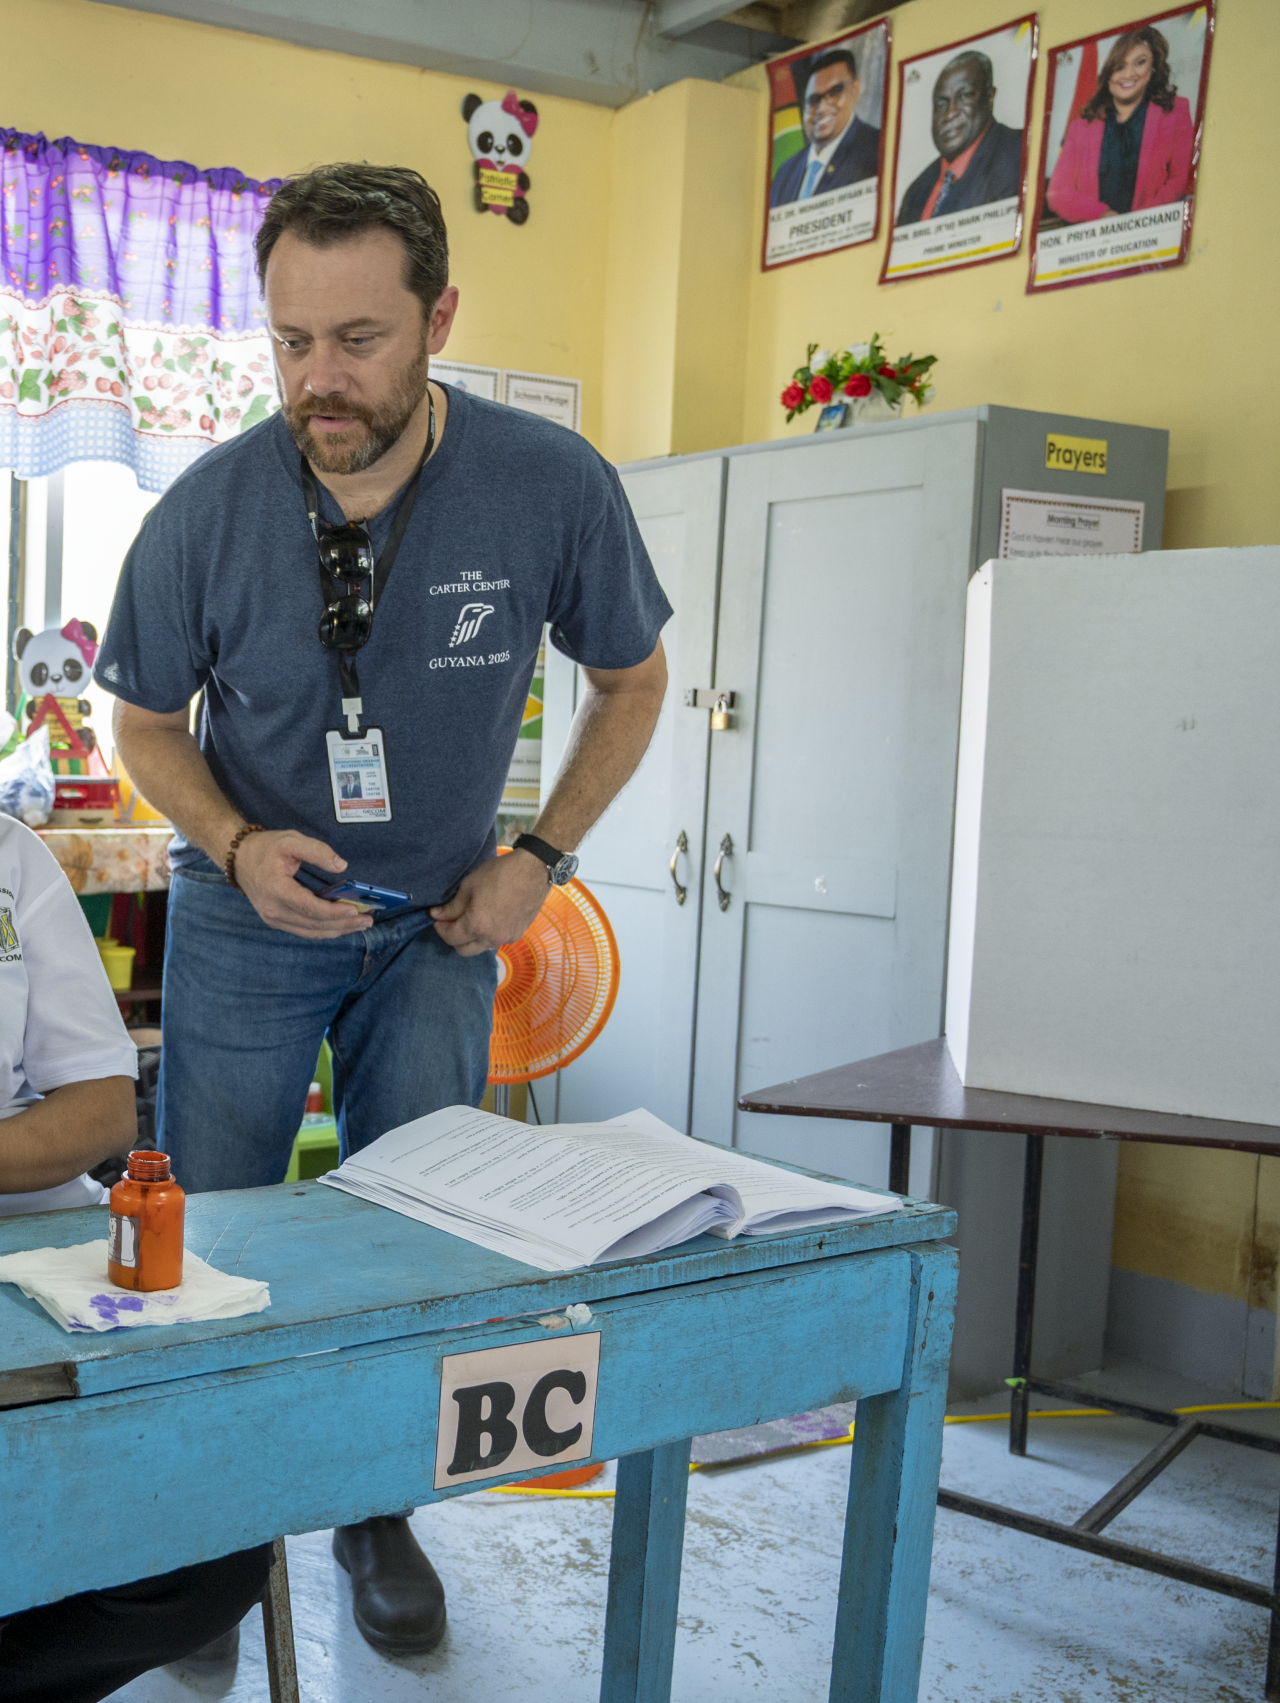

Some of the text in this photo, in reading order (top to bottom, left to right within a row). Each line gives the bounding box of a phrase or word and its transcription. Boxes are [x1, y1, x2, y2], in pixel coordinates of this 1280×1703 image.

[789, 208, 853, 239] PRESIDENT
[1040, 210, 1181, 249] HON. PRIYA MANICKCHAND
[947, 235, 982, 249] MINISTER
[1058, 237, 1158, 265] MINISTER OF EDUCATION
[1046, 442, 1106, 471] Prayers
[1048, 513, 1100, 529] Morning Prayer
[429, 579, 510, 595] CARTER CENTER
[460, 571, 482, 580] THE
[429, 650, 510, 669] GUYANA 2025
[447, 1369, 587, 1476] BC
